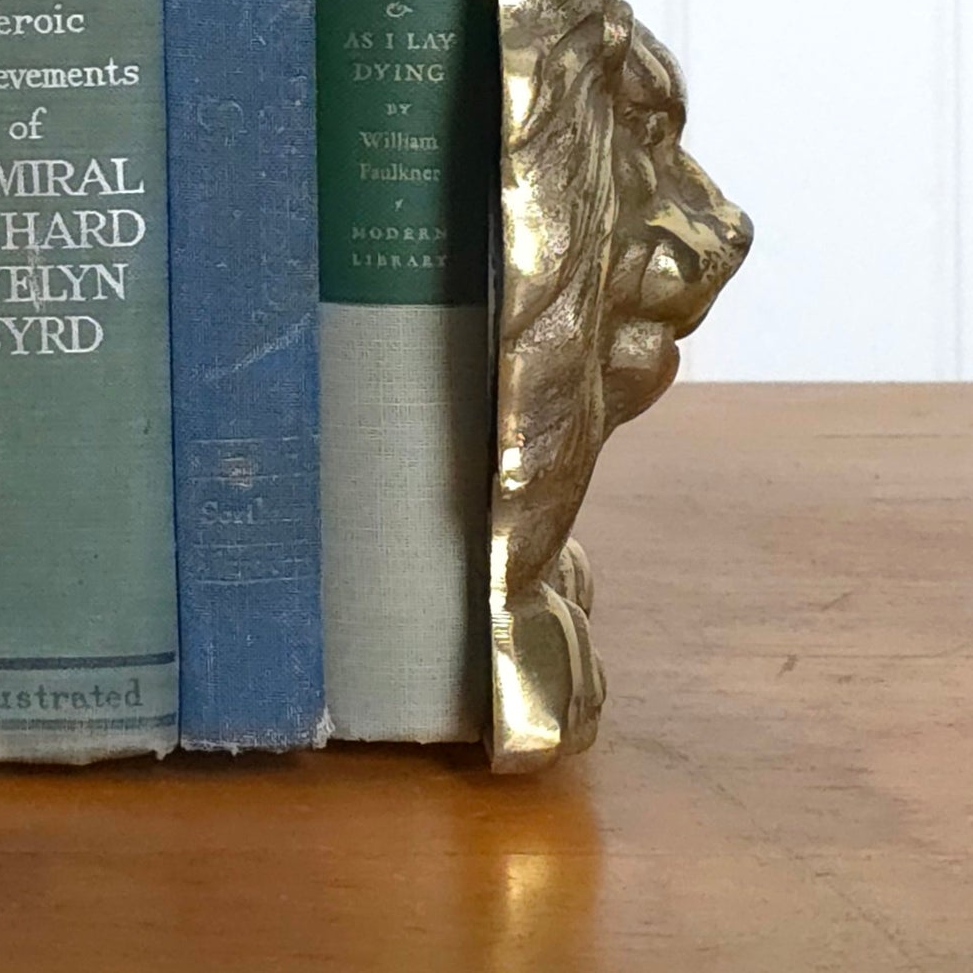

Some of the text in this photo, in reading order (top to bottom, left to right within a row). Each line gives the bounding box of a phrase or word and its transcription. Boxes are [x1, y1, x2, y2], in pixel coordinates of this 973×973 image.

[343, 32, 457, 51] AS I LAY
[353, 64, 446, 83] DYING
[9, 107, 48, 140] of
[359, 131, 440, 151] William
[359, 163, 442, 181] Faulkner
[351, 227, 448, 241] MODERN
